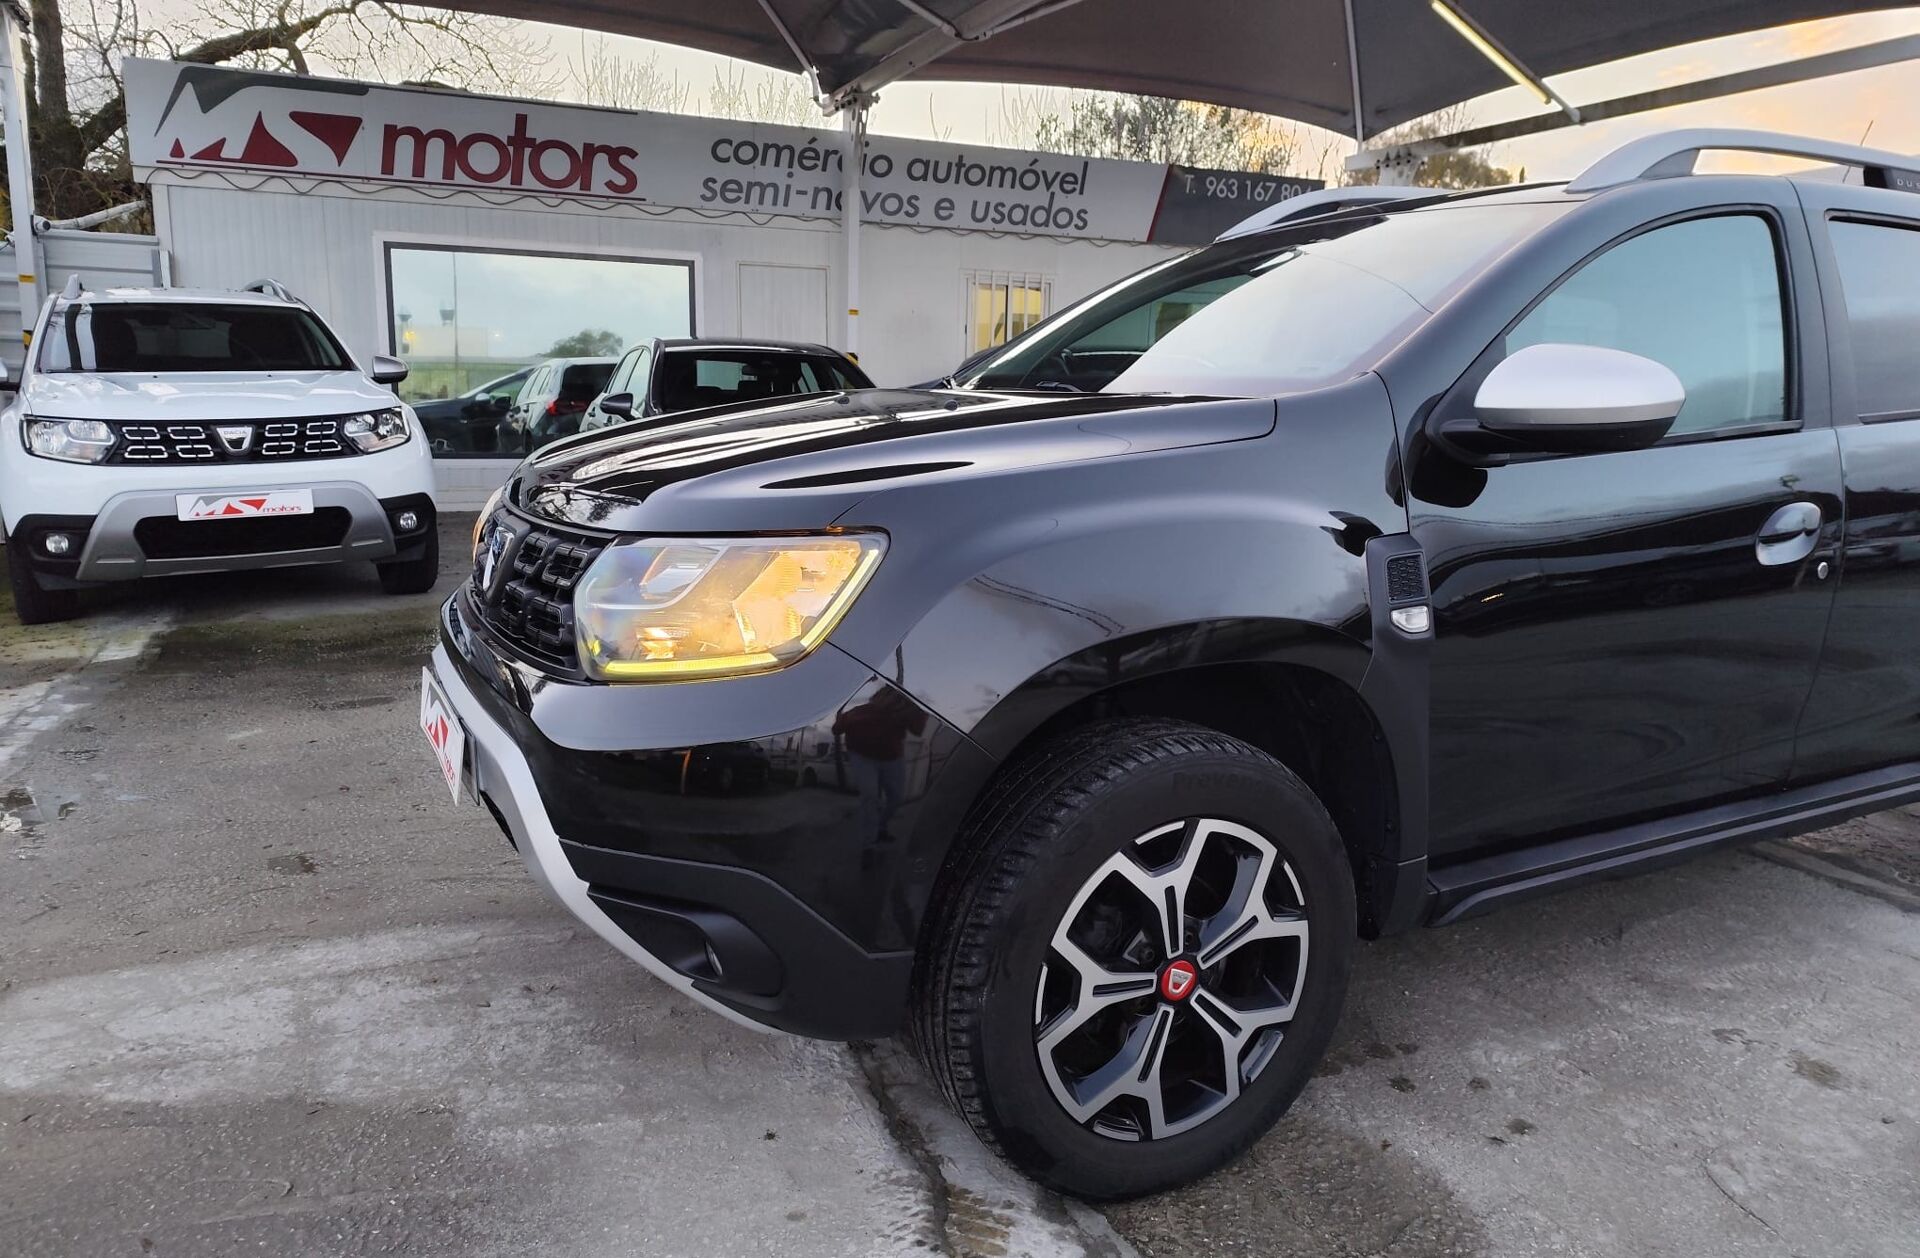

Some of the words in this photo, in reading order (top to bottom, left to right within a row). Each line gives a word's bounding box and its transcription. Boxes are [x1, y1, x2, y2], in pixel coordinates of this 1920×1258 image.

[381, 113, 640, 194] motors
[907, 159, 1090, 196] automóvel
[1184, 175, 1196, 195] T.
[1206, 176, 1238, 199] 963
[1246, 180, 1277, 202] 167
[934, 197, 956, 221] e
[970, 192, 1089, 231] usados
[263, 505, 302, 513] motors
